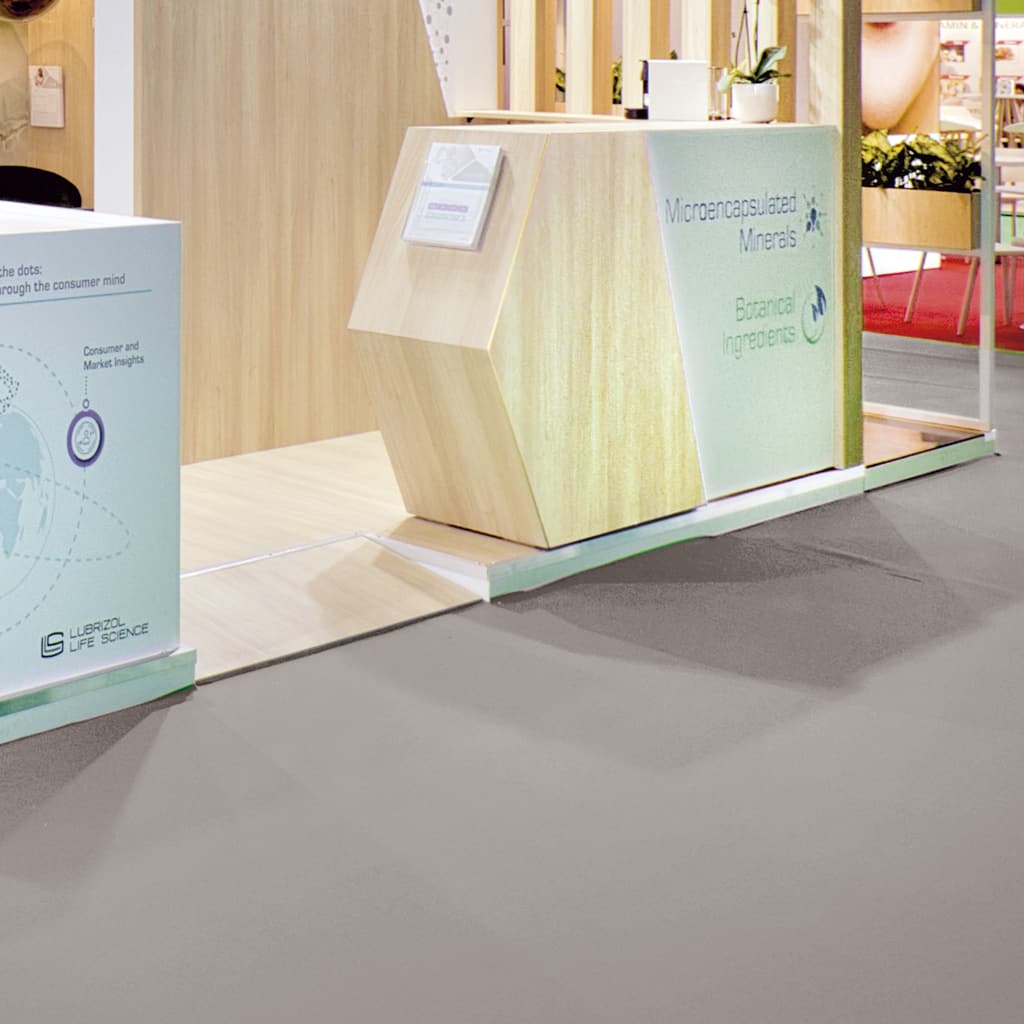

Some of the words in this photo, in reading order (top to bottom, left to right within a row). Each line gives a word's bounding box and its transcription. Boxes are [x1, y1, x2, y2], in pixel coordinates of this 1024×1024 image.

[665, 187, 797, 225] Microencapsulated
[739, 225, 797, 254] Minerals
[17, 264, 42, 277] dots:
[34, 279, 51, 292] the
[53, 276, 101, 290] consumer
[103, 273, 126, 286] mind
[83, 345, 124, 357] Consumer
[125, 339, 139, 352] and
[83, 359, 113, 371] Market
[114, 355, 144, 368] Insights
[69, 616, 126, 639] LUBRIZOL
[69, 636, 95, 653] LIFE
[101, 623, 149, 645] SCIENCE
